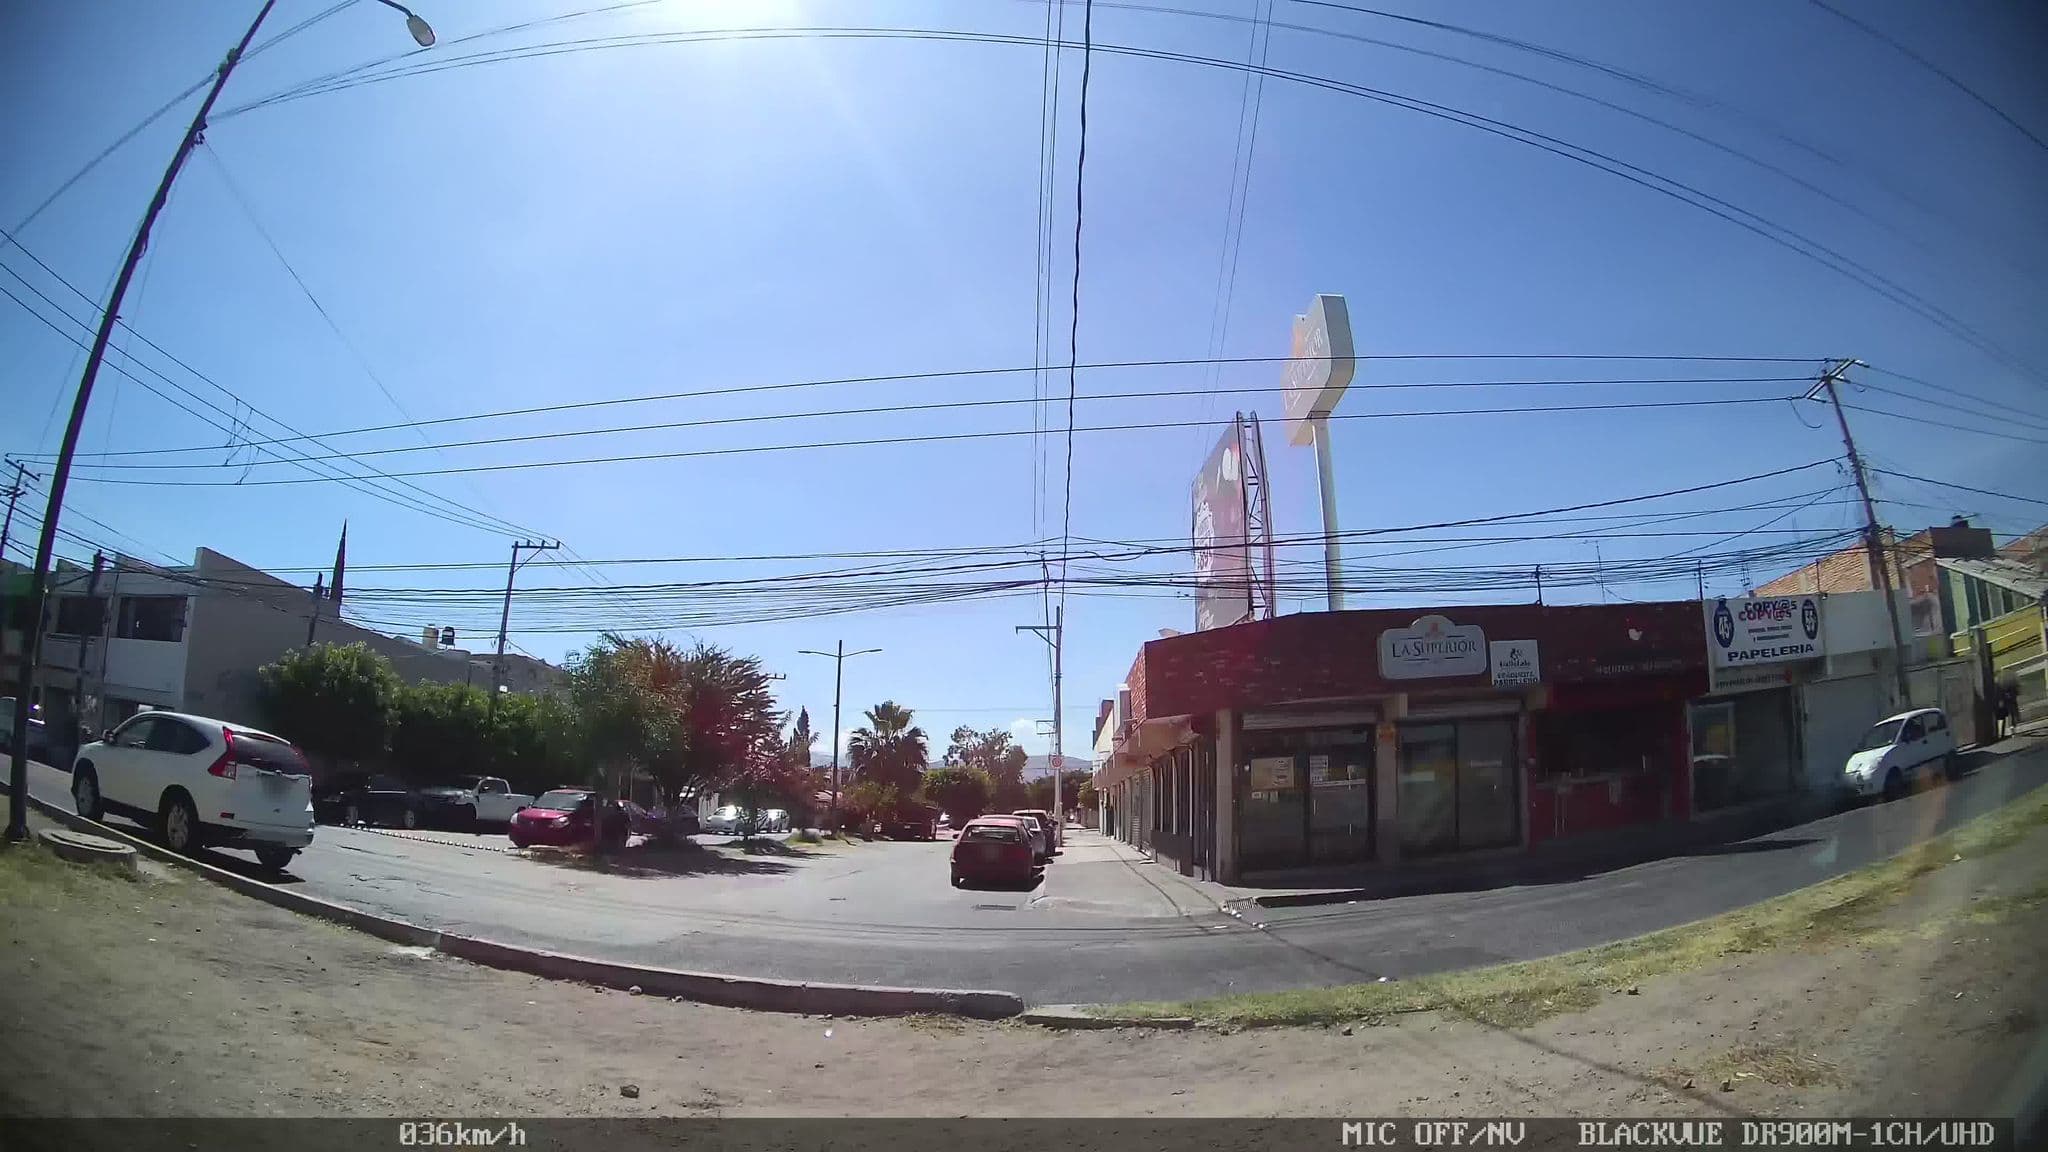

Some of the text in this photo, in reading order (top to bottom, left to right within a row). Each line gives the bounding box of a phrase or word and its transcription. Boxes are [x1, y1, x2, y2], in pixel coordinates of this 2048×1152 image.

[1392, 640, 1478, 658] LA SUPERIOR
[1727, 643, 1814, 662] PAPELERIA
